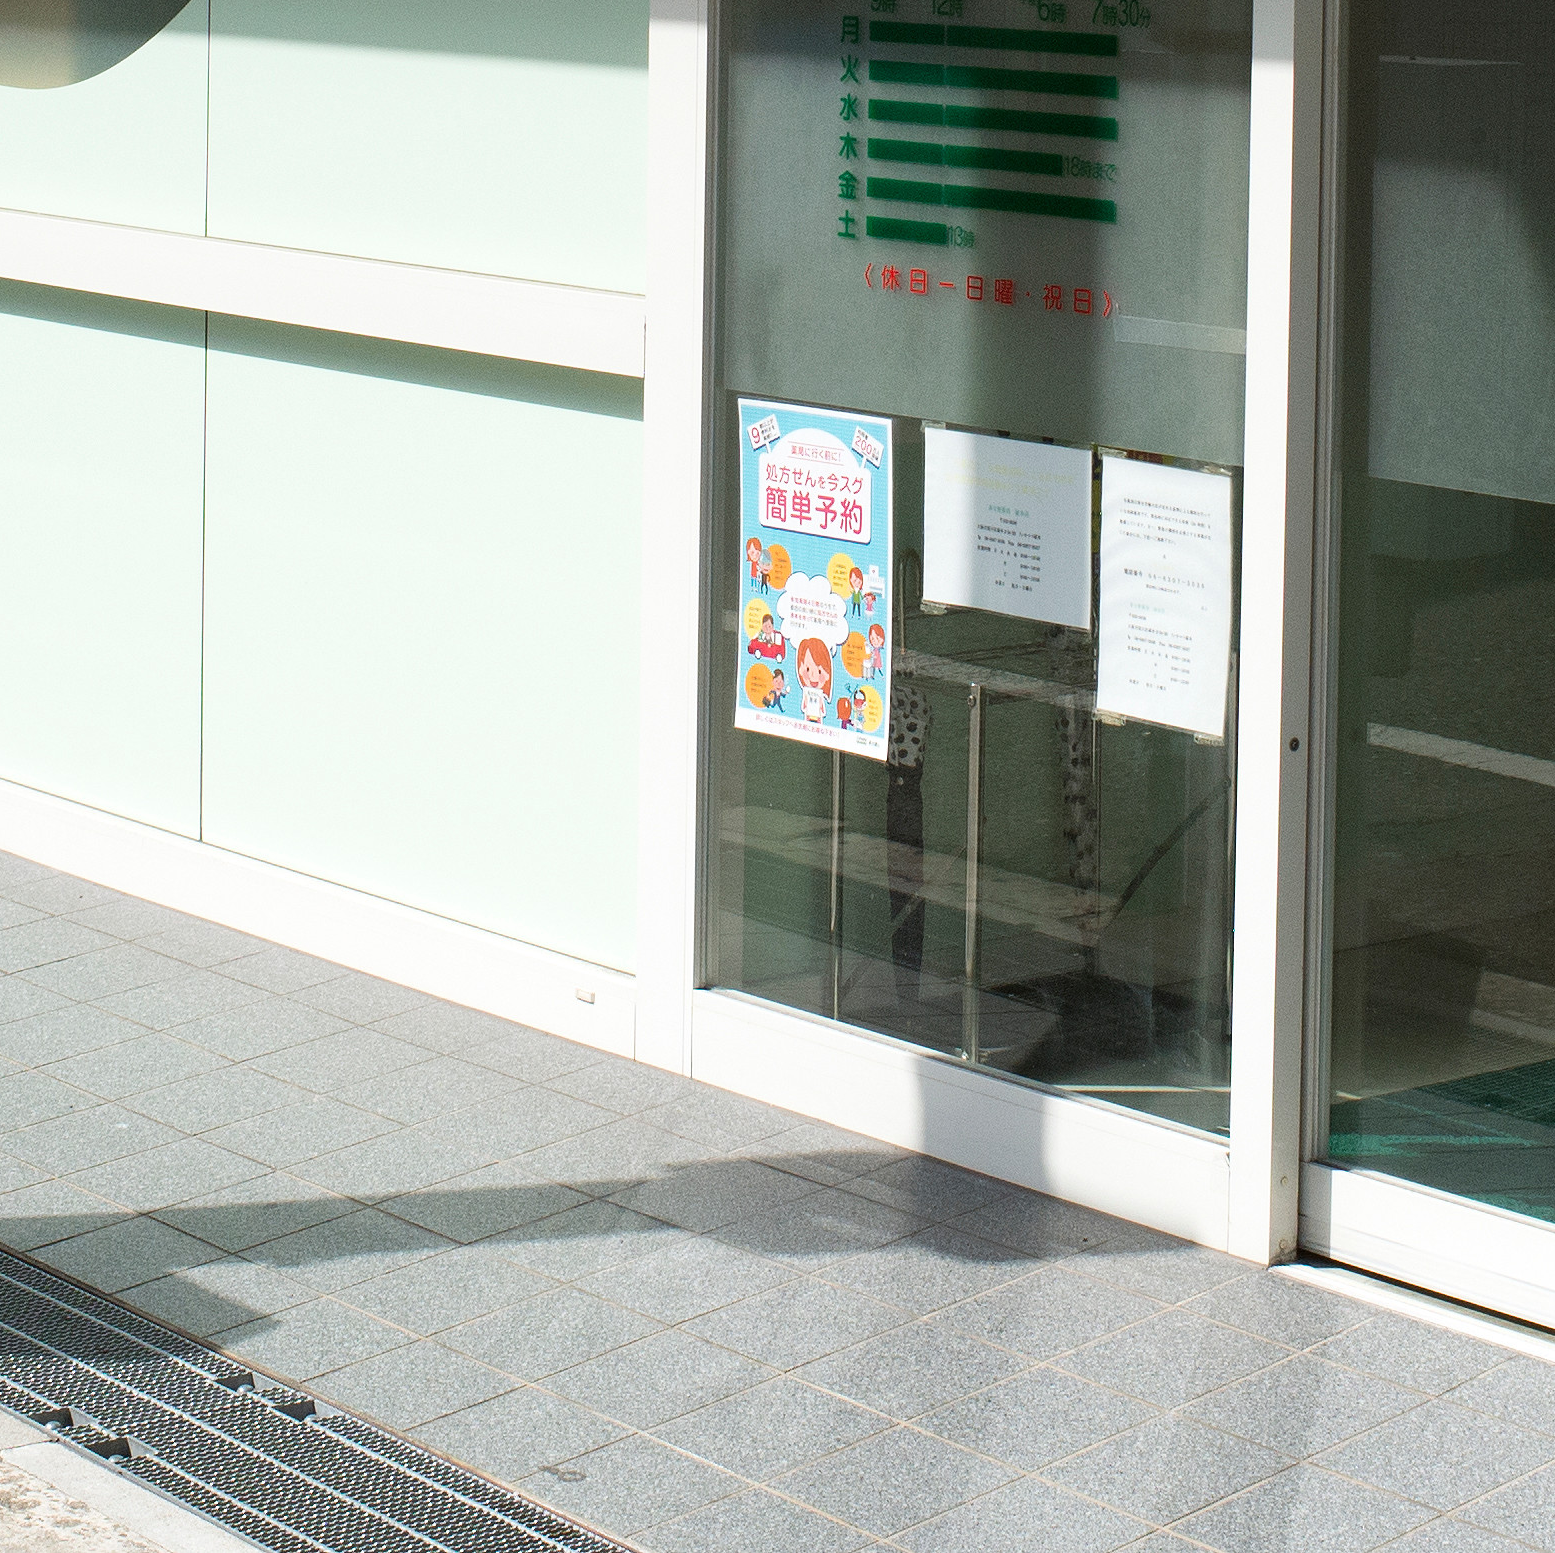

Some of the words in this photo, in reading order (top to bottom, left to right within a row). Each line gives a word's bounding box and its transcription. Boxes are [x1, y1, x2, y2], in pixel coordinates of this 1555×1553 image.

[840, 15, 861, 45] 月
[839, 54, 860, 84] 火
[839, 93, 859, 122] 水
[838, 131, 859, 161] 木
[837, 169, 859, 199] 金
[837, 209, 859, 240] 土
[751, 427, 761, 444] 9
[765, 463, 863, 495] 処方せんを今スグ
[765, 486, 863, 535] 簡単予約
